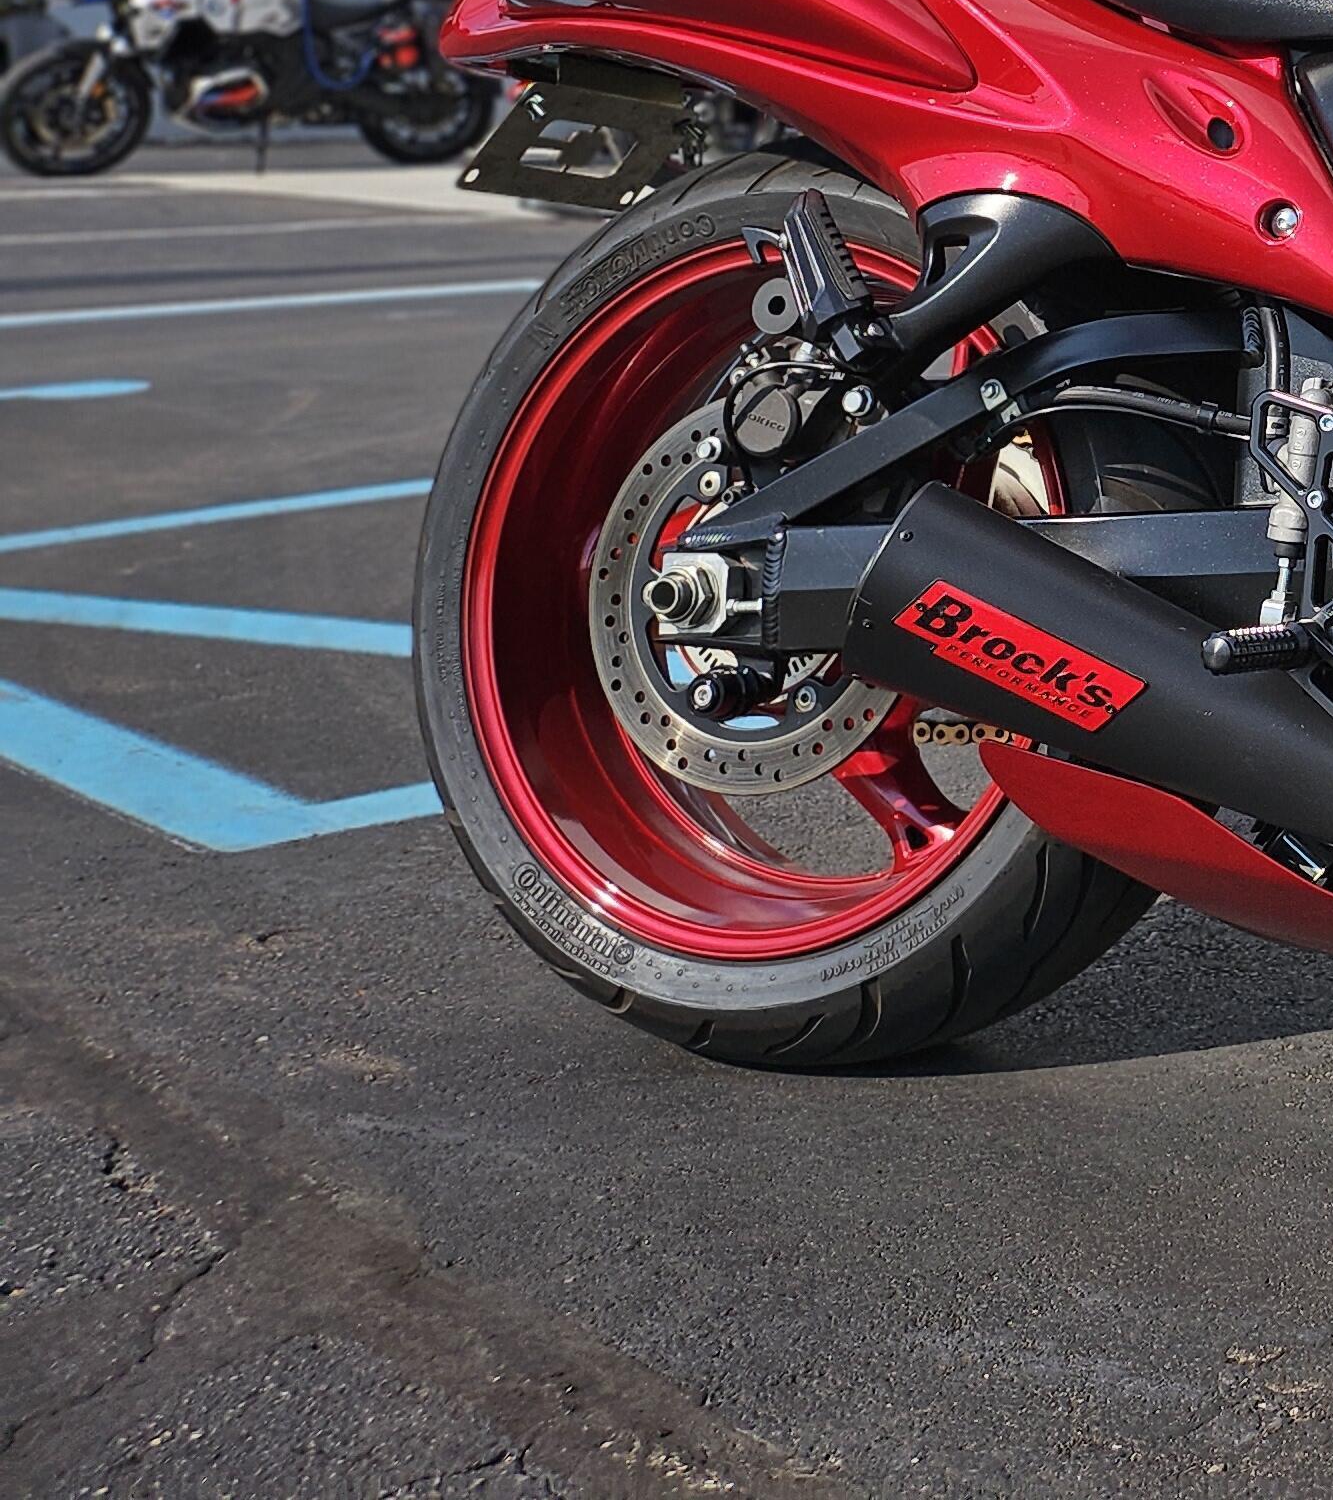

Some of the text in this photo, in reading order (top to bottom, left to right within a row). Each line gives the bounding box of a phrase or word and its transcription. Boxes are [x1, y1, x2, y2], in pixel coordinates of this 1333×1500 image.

[915, 594, 1113, 708] Brock's
[513, 862, 617, 959] Continental
[820, 955, 863, 982] 190/50
